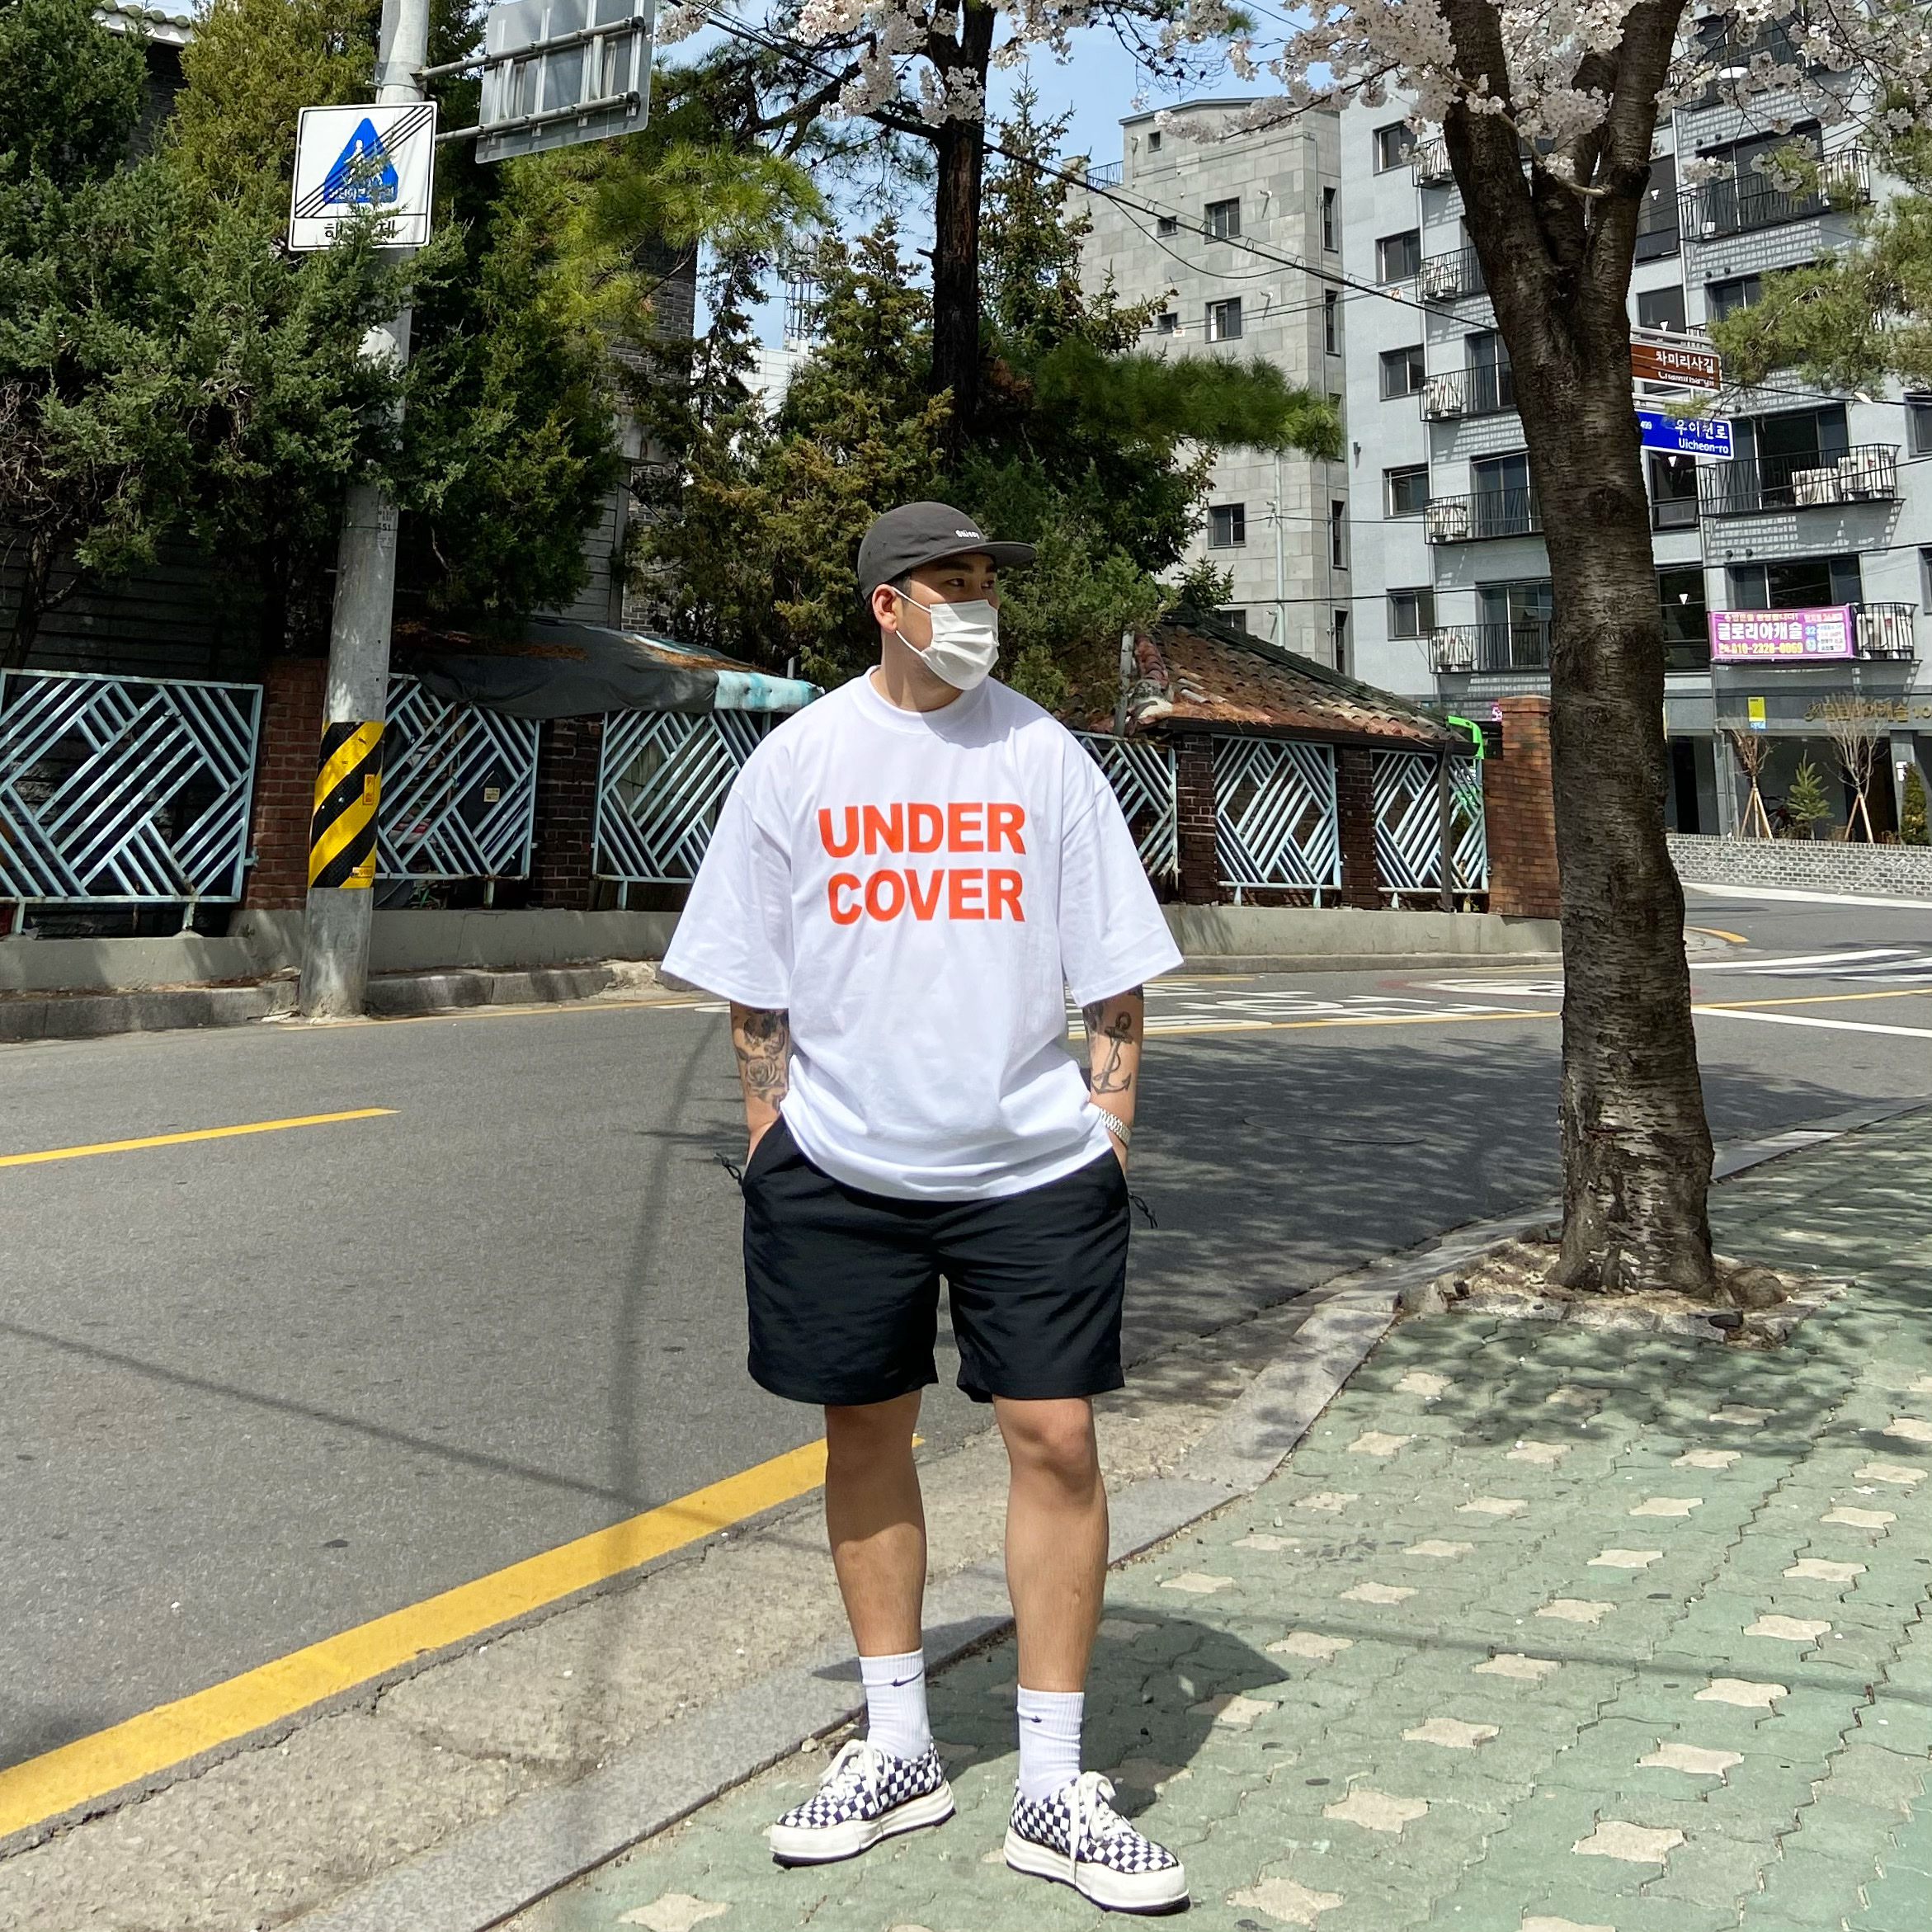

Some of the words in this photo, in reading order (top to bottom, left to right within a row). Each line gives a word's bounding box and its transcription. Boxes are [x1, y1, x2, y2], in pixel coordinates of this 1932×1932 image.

[1655, 350, 1714, 374] 차미리사길
[1674, 419, 1728, 440] 우이천로
[1678, 437, 1729, 454] Uicheon-ro
[1718, 621, 1803, 640] 글로리아캐슬
[818, 802, 1026, 858] UNDER
[827, 869, 1025, 925] COVER
